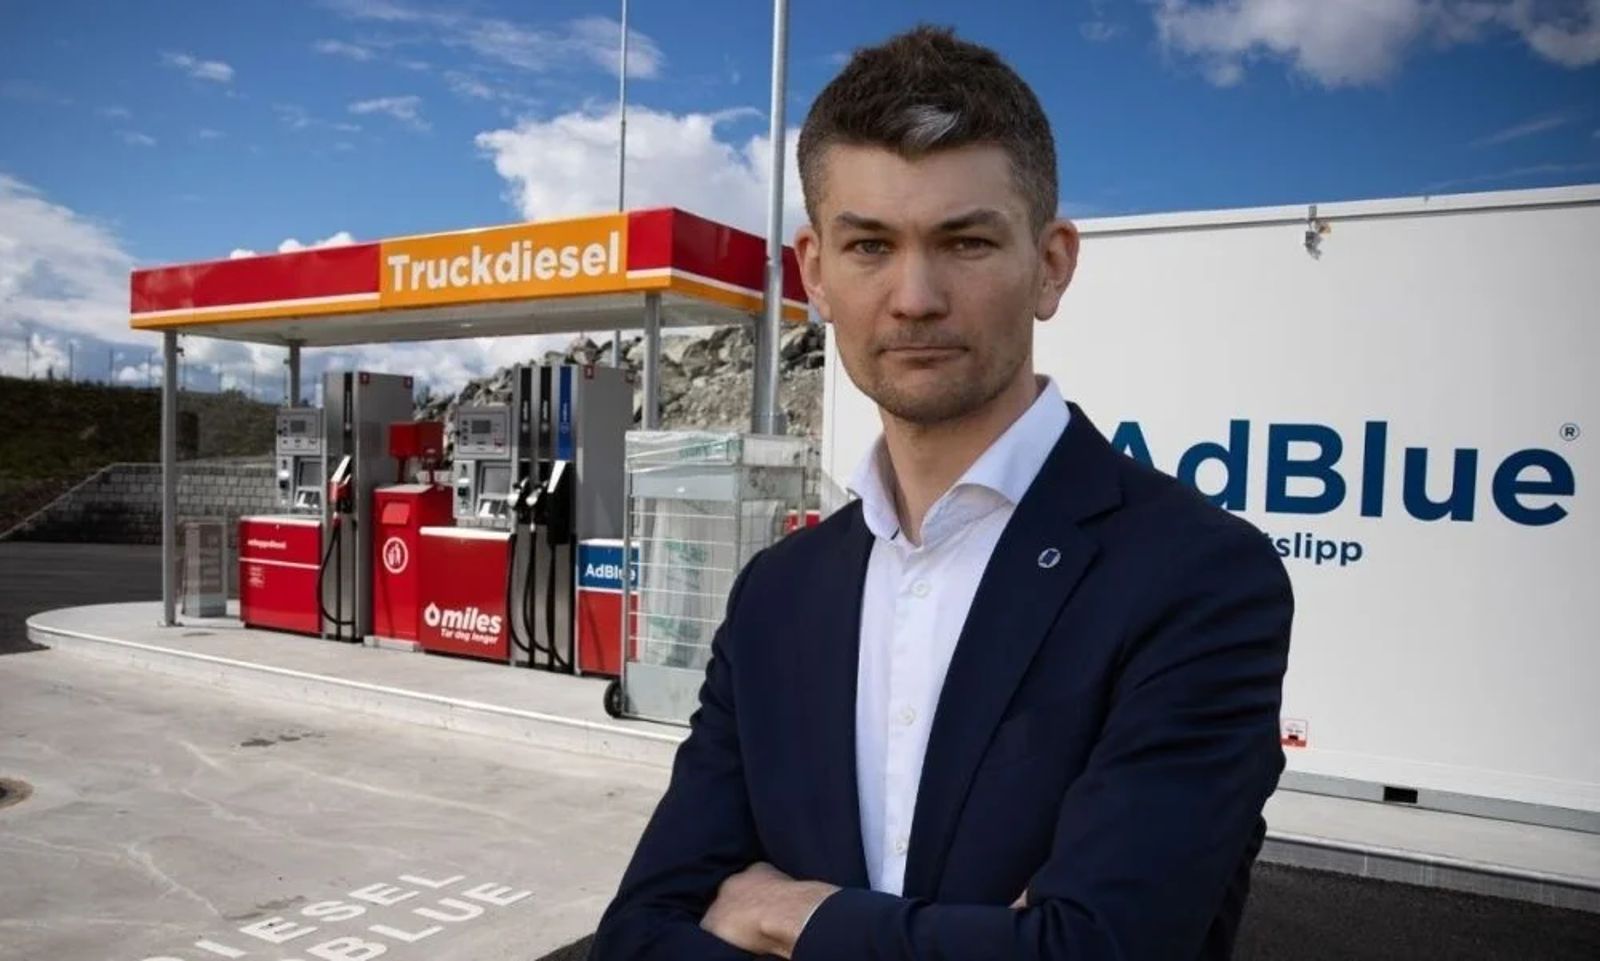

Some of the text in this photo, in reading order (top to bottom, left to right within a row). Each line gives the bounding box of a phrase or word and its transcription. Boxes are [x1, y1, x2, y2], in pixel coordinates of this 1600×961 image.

[387, 231, 620, 292] Truckdiesel
[441, 607, 502, 635] miles
[143, 874, 466, 961] IESEL
[280, 882, 534, 961] BLUE
